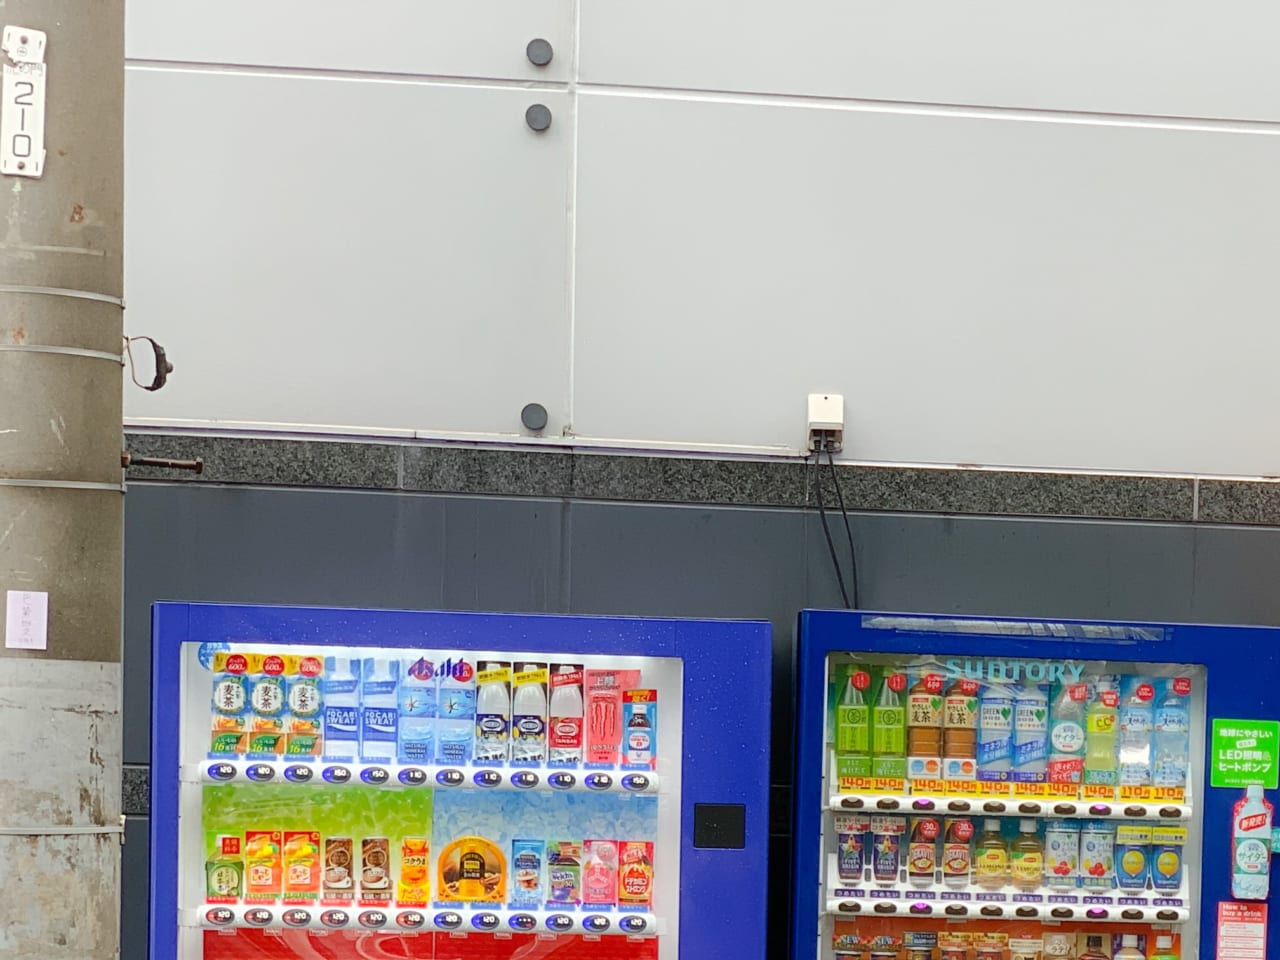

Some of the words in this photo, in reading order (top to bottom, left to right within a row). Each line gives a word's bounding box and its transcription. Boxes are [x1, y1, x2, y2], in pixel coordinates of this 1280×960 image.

[407, 656, 464, 677] Asahi
[945, 658, 1086, 684] SUNTORY
[223, 684, 234, 709] 麦茶
[261, 686, 272, 710] 麦茶
[298, 687, 309, 710] 麦茶
[365, 711, 396, 719] POCARI
[912, 711, 931, 723] 麦茶
[948, 713, 967, 725] 麦茶
[1054, 733, 1082, 742] サイダー
[1219, 728, 1273, 738] 地球にやさしい
[1219, 762, 1272, 773] ヒートポンプ
[841, 778, 872, 787] 140円
[874, 779, 904, 788] 140円
[913, 780, 943, 789] 140円
[947, 780, 977, 790] 140円
[980, 782, 1010, 791] 140円
[1015, 784, 1045, 793] 140円
[1049, 785, 1078, 794] 140円
[1084, 786, 1114, 795] 140円
[1121, 787, 1151, 797] 110円
[1154, 788, 1183, 798] 110円
[1237, 851, 1267, 862] サイダー
[1222, 909, 1236, 918] buy
[1243, 909, 1262, 917] drink
